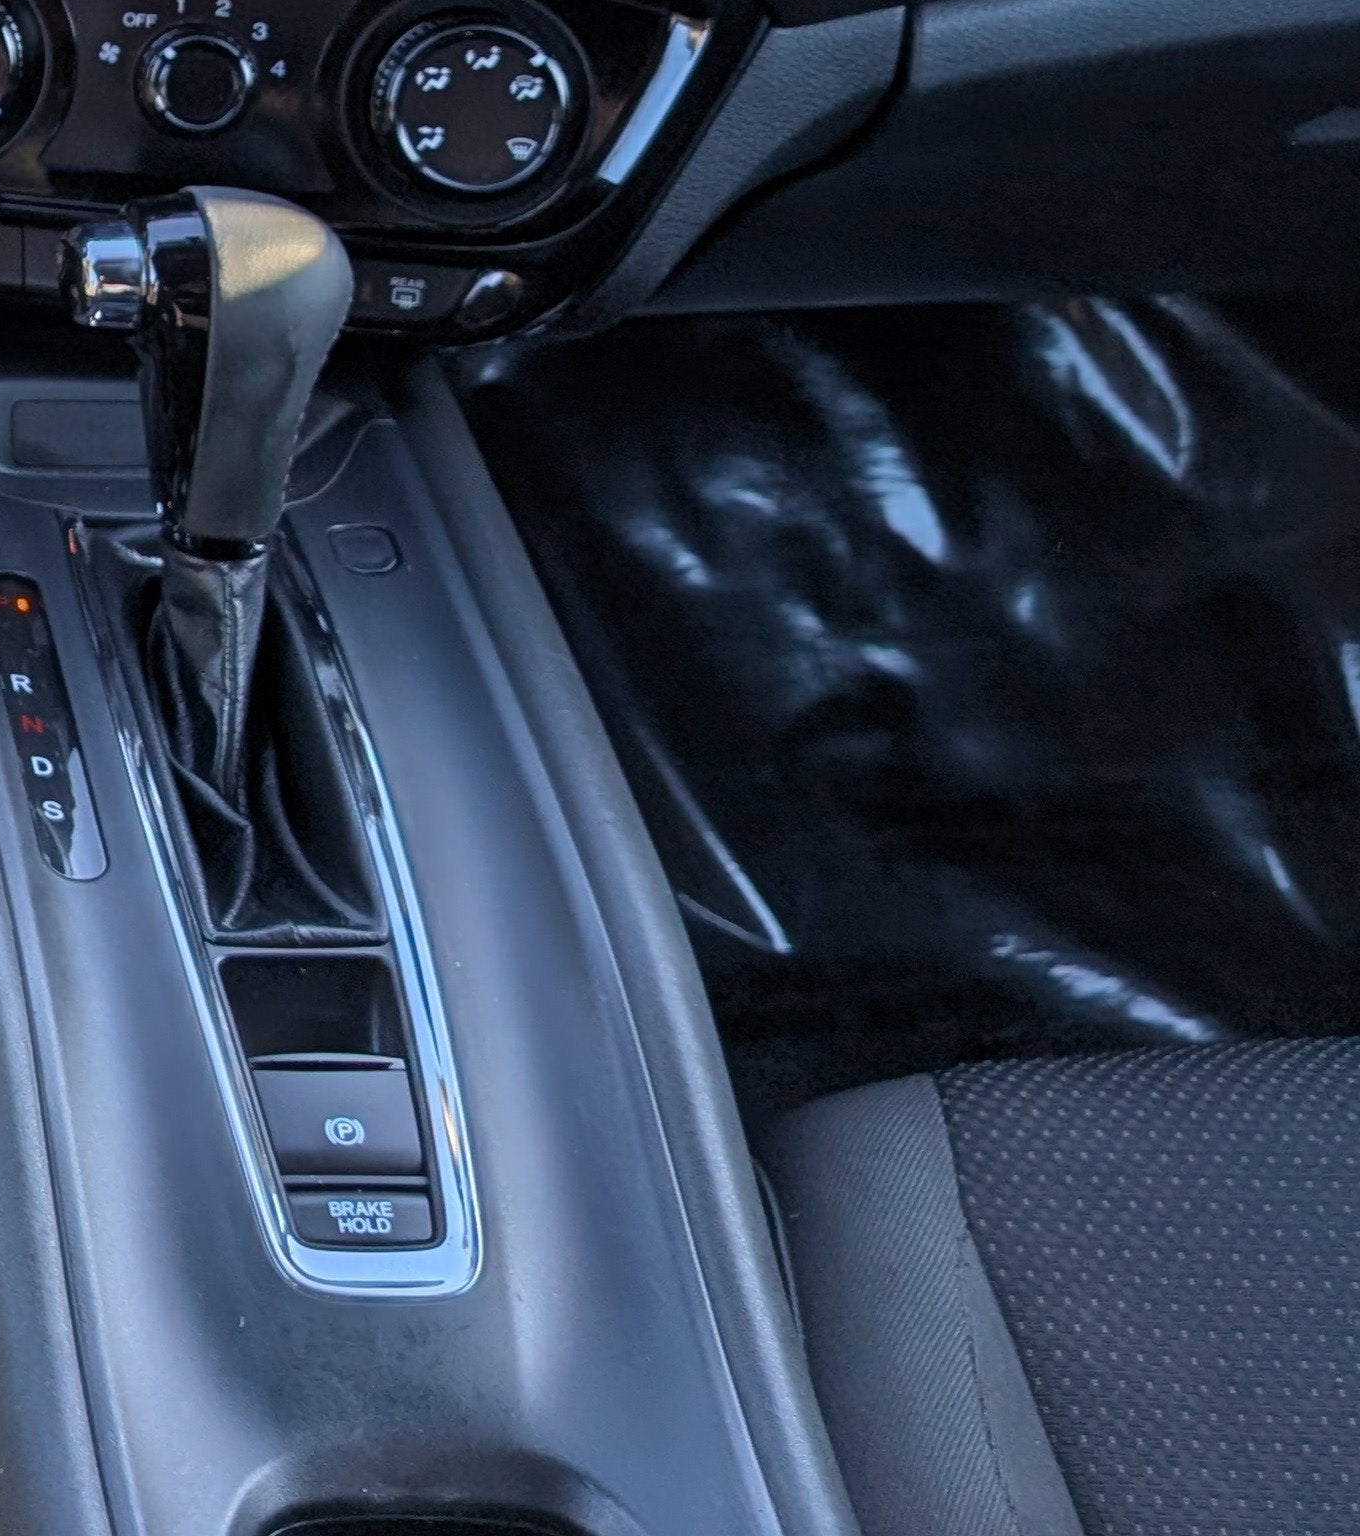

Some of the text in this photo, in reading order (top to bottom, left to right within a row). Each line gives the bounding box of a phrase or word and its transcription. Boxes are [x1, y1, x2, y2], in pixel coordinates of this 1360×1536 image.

[122, 11, 159, 29] OFF
[251, 21, 270, 42] 3
[269, 59, 288, 79] 4
[10, 673, 34, 695] R
[30, 755, 54, 777] D
[42, 800, 65, 822] S
[328, 1201, 394, 1219] BRAKE
[338, 1217, 393, 1234] HOLD
